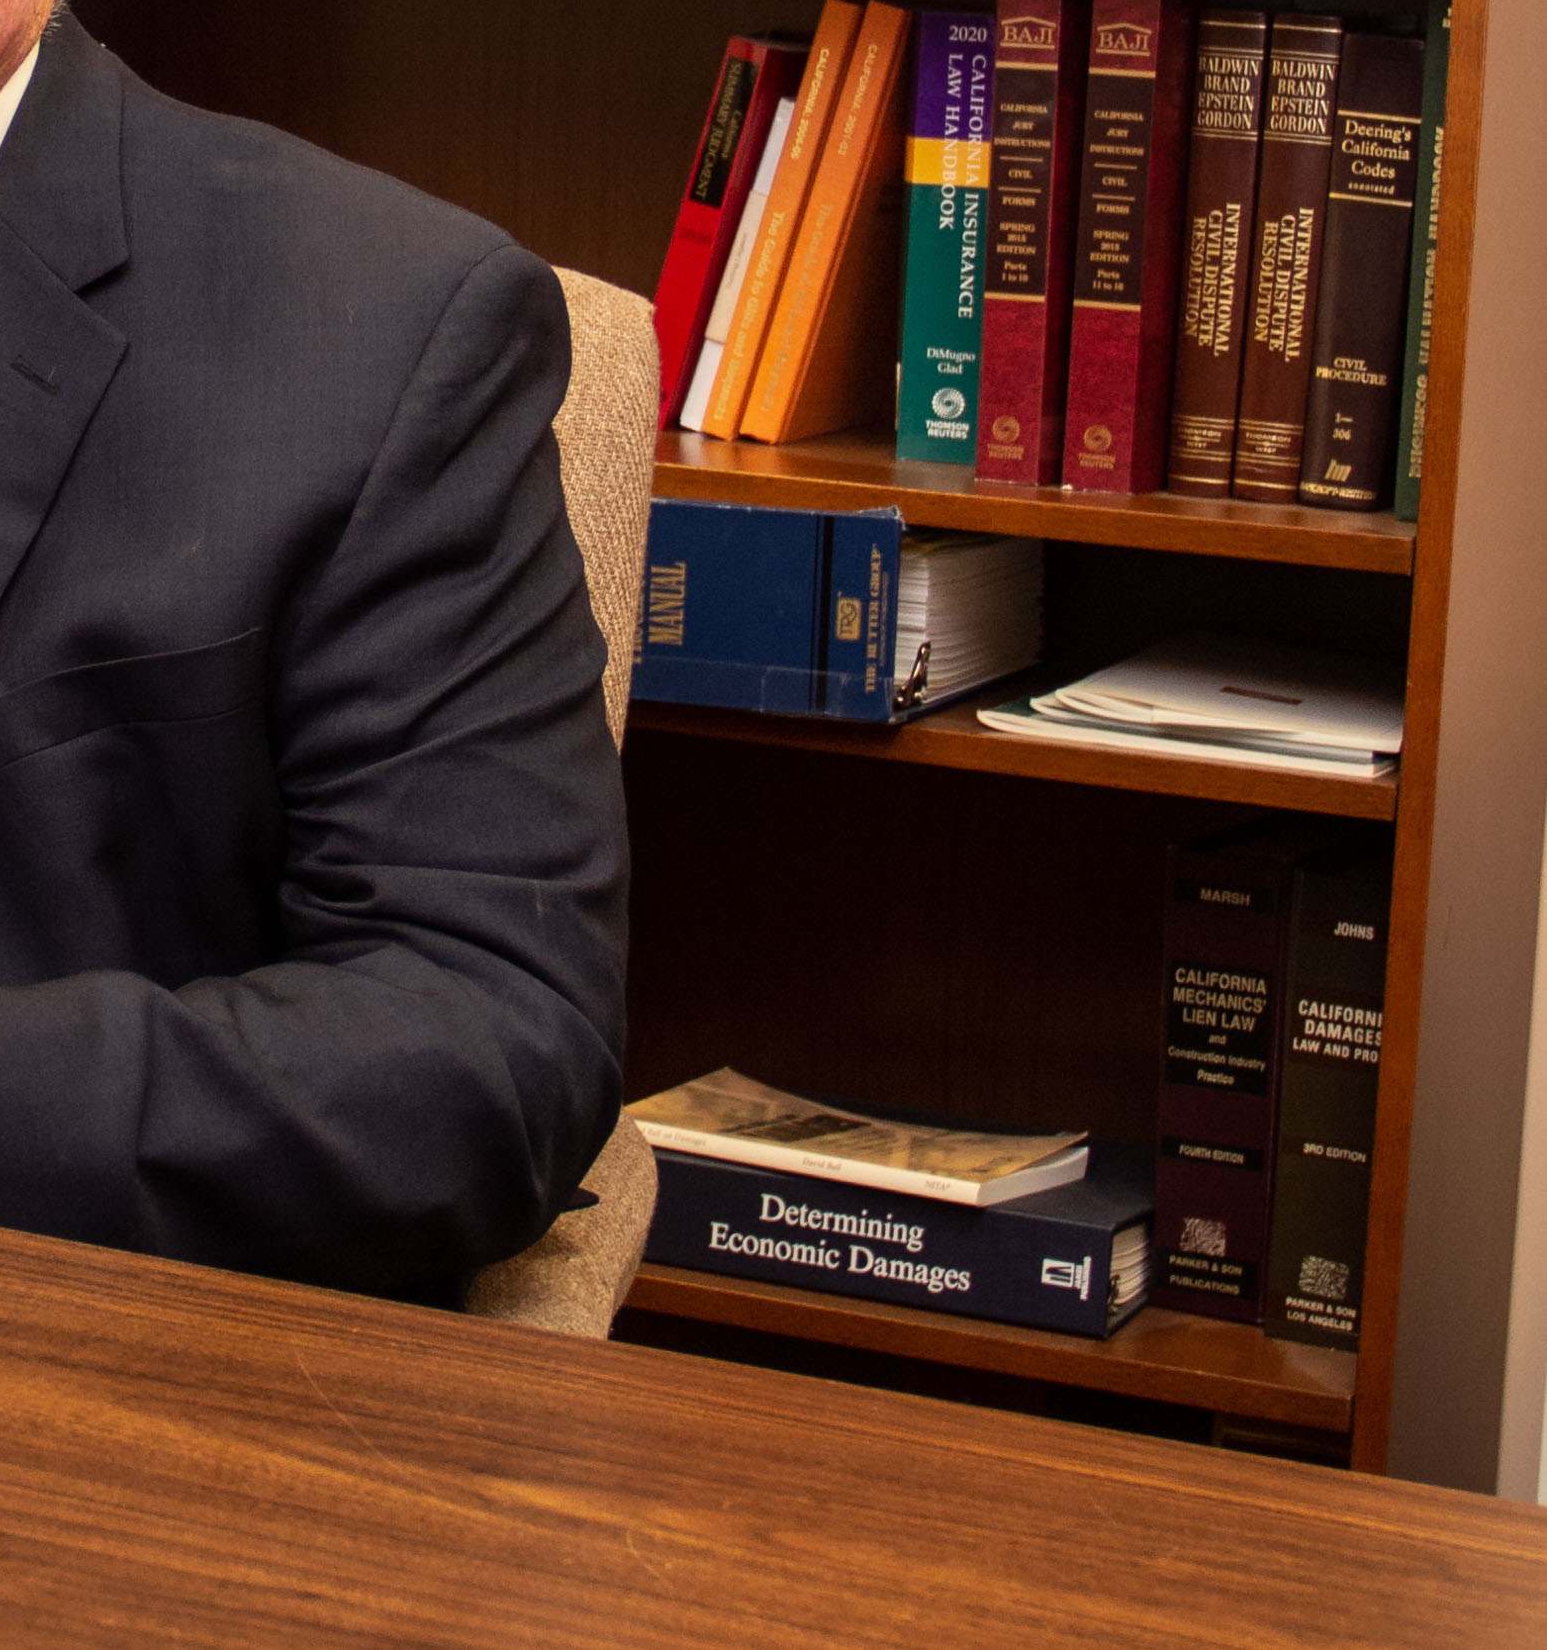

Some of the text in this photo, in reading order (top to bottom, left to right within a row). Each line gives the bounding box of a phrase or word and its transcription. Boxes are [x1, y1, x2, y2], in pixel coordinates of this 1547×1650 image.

[949, 25, 987, 42] 2020
[1004, 26, 1054, 44] BAJI
[1099, 32, 1149, 50] BAJI
[1198, 56, 1259, 76] BALDWIN
[1271, 59, 1336, 81] BALDWIN
[1204, 74, 1250, 93] BRAND
[1278, 78, 1326, 98] BRAND
[1000, 103, 1048, 114] CALIFORNIA
[1198, 92, 1254, 112] EPSTEIN
[1271, 96, 1330, 116] EPSTEIN
[1094, 110, 1144, 122] CALIFORNIA
[1197, 110, 1252, 130] GORDON
[1270, 115, 1327, 135] GORDON
[939, 53, 963, 230] LAW HANDBOOK
[1345, 119, 1412, 144] Deering's
[1341, 139, 1411, 161] California
[695, 126, 724, 199] JUDGMENT
[1351, 160, 1396, 180] Codes
[1008, 169, 1033, 179] CIVIL
[1102, 176, 1128, 187] CIVIL
[957, 54, 987, 319] CALIFORNIA INSURANCE
[1348, 181, 1395, 195] annotated
[1002, 197, 1036, 207] FORMS
[1096, 204, 1130, 214] FORMS
[999, 222, 1036, 233] SPRING
[1093, 230, 1130, 241] SPRING
[996, 244, 1036, 255] EDITION
[1089, 252, 1130, 263] EDITION
[1185, 216, 1207, 338] RESOLUTION
[1198, 209, 1224, 347] CIVIL DISPUTE
[1213, 202, 1241, 357] INTERNATIONAL
[1254, 221, 1279, 342] RESOLUTION
[1268, 214, 1296, 352] CIVIL DISPUTE
[1284, 206, 1315, 363] INTERNATIONAL
[926, 347, 976, 361] DiMugno
[1333, 356, 1367, 371] CIVIL
[937, 362, 963, 374] Glad
[1315, 366, 1388, 386] PROCEDURE
[925, 420, 970, 431] THOMSON
[927, 429, 967, 440] REUTERS
[648, 561, 687, 647] MANUAL
[1200, 888, 1251, 906] MARSH
[1333, 921, 1374, 941] JOHNS
[1175, 967, 1267, 995] CALIFORNIA
[1173, 986, 1267, 1014] MECHANICS'
[1182, 1007, 1256, 1032] LIEN LAW
[1298, 999, 1382, 1028] CALIFORNI
[1208, 1033, 1227, 1045] and
[1304, 1018, 1382, 1047] DAMAGES
[1168, 1045, 1266, 1072] Construction Industry
[1292, 1036, 1379, 1064] LAW AND PRO
[1197, 1068, 1235, 1085] Practice
[1179, 1144, 1245, 1165] FOURTH EDITION
[1303, 1142, 1366, 1163] 3RD EDITION
[759, 1193, 925, 1253] Determining
[709, 1221, 972, 1293] Economic Damages
[1169, 1254, 1243, 1276] PARKER & SON
[1169, 1274, 1241, 1295] PUBLICATIONS
[1285, 1296, 1357, 1318] PARKER & SON
[1286, 1310, 1353, 1331] LOS ANGELES
